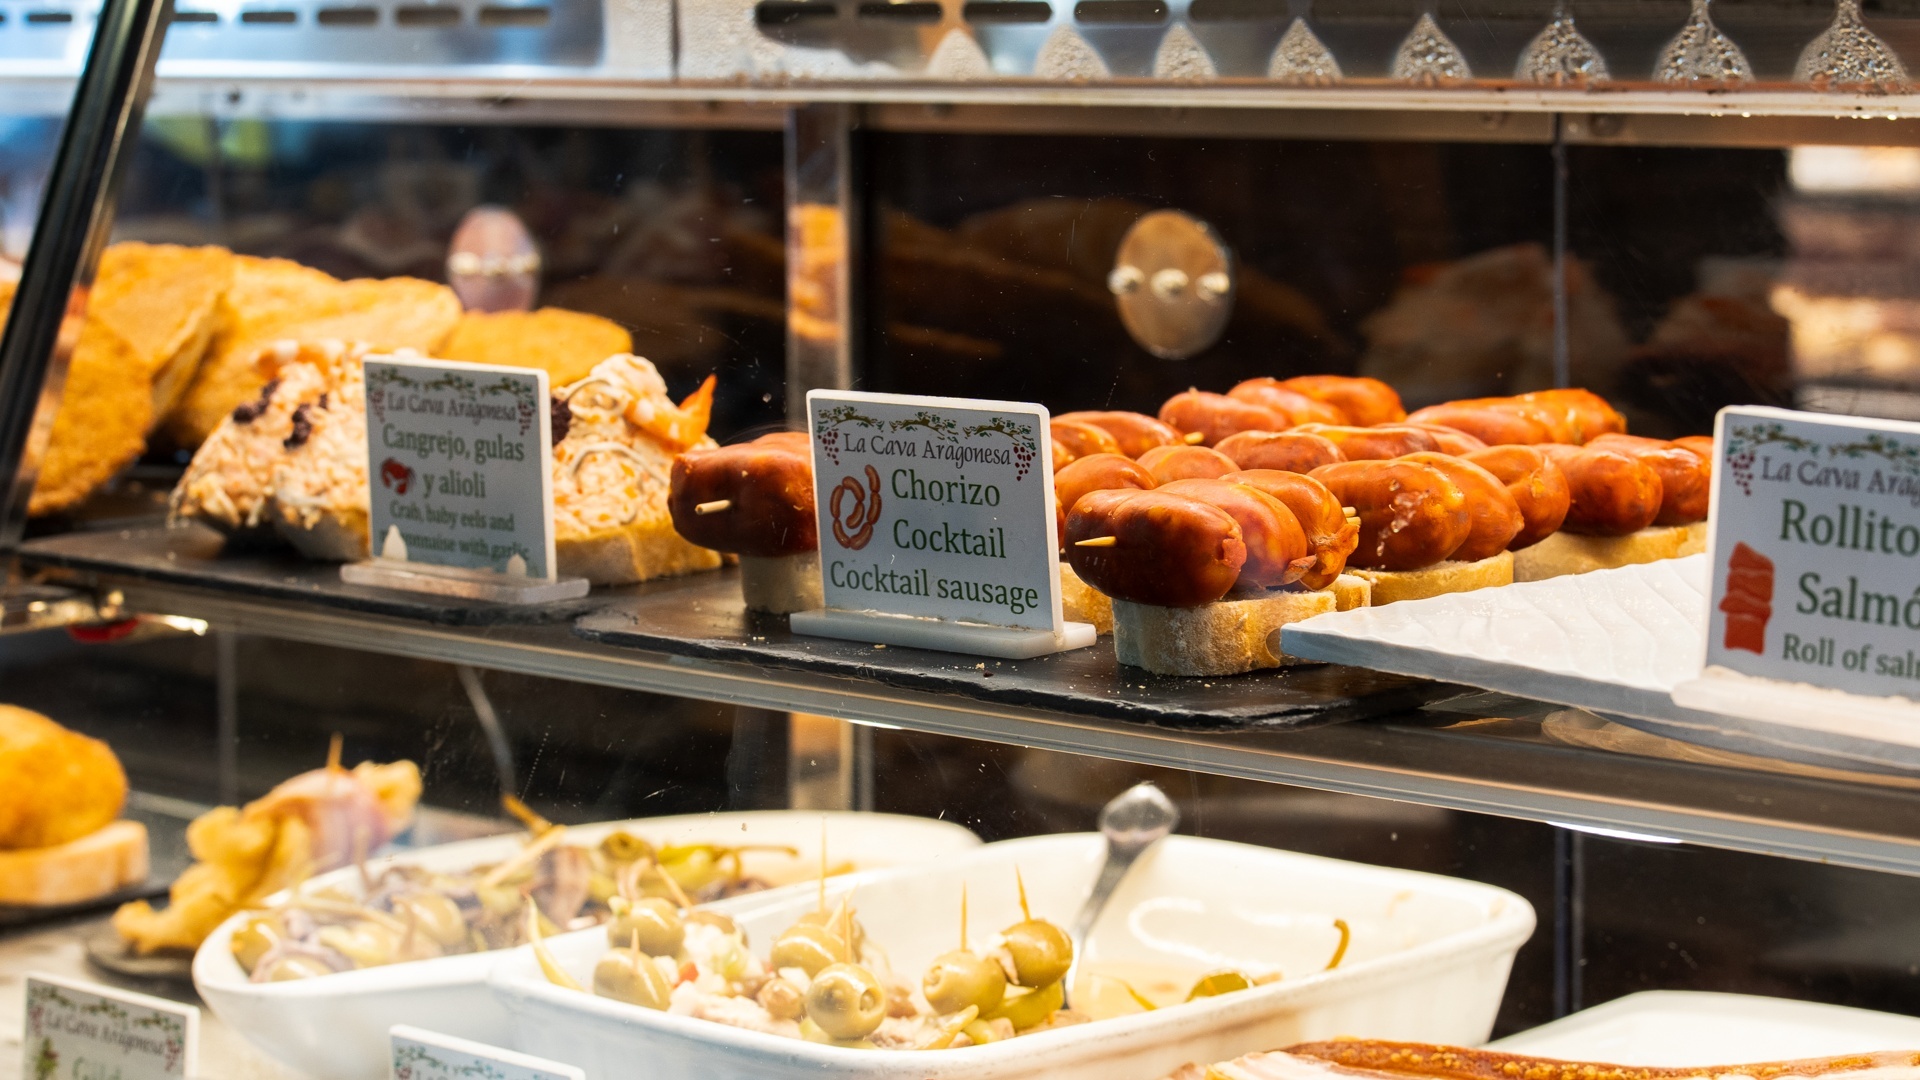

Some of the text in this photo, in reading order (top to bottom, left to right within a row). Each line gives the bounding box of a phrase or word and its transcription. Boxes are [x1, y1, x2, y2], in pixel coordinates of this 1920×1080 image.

[388, 392, 516, 425] La Cava Aragonesa
[382, 423, 525, 464] Cangrejo, gulas
[843, 433, 1011, 469] La Cava Aragonesa
[422, 470, 487, 498] y alioli
[891, 468, 1001, 507] Chorizo
[1761, 456, 1791, 482] La
[1797, 460, 1860, 490] Cava
[426, 504, 457, 529] baby
[461, 509, 487, 528] eels
[489, 513, 515, 532] and
[459, 538, 489, 555] with
[893, 519, 1006, 559] Cocktail
[830, 560, 1039, 615] Cocktail sausage
[1782, 633, 1920, 680] Roll of sal
